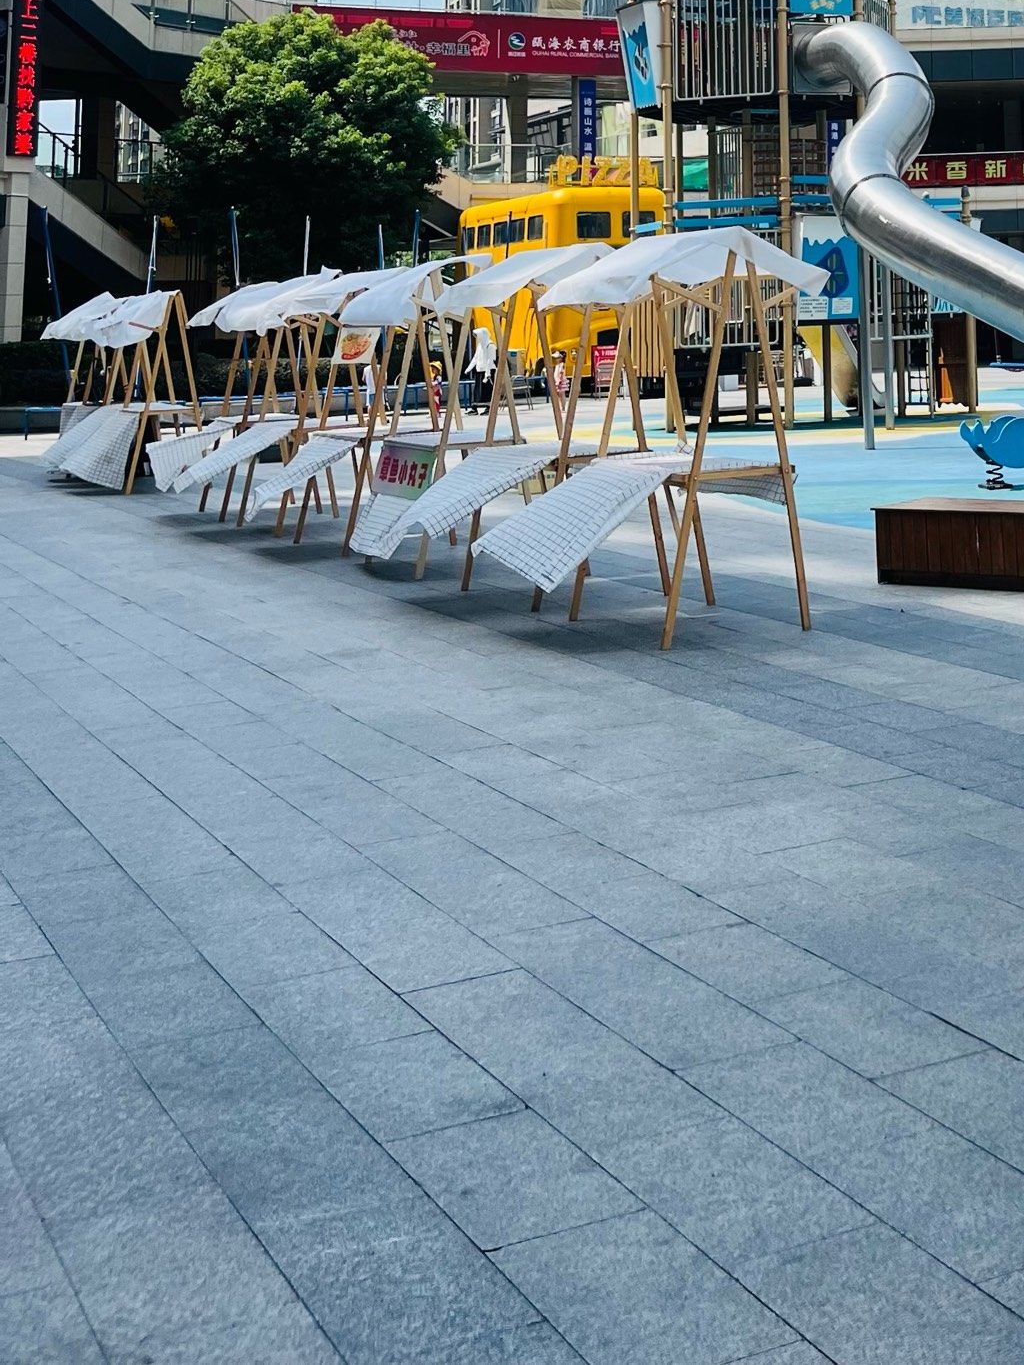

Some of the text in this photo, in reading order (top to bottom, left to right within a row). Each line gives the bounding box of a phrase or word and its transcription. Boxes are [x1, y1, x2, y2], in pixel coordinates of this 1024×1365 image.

[531, 36, 621, 53] 瓯海农商银行
[555, 153, 659, 187] PIZZA
